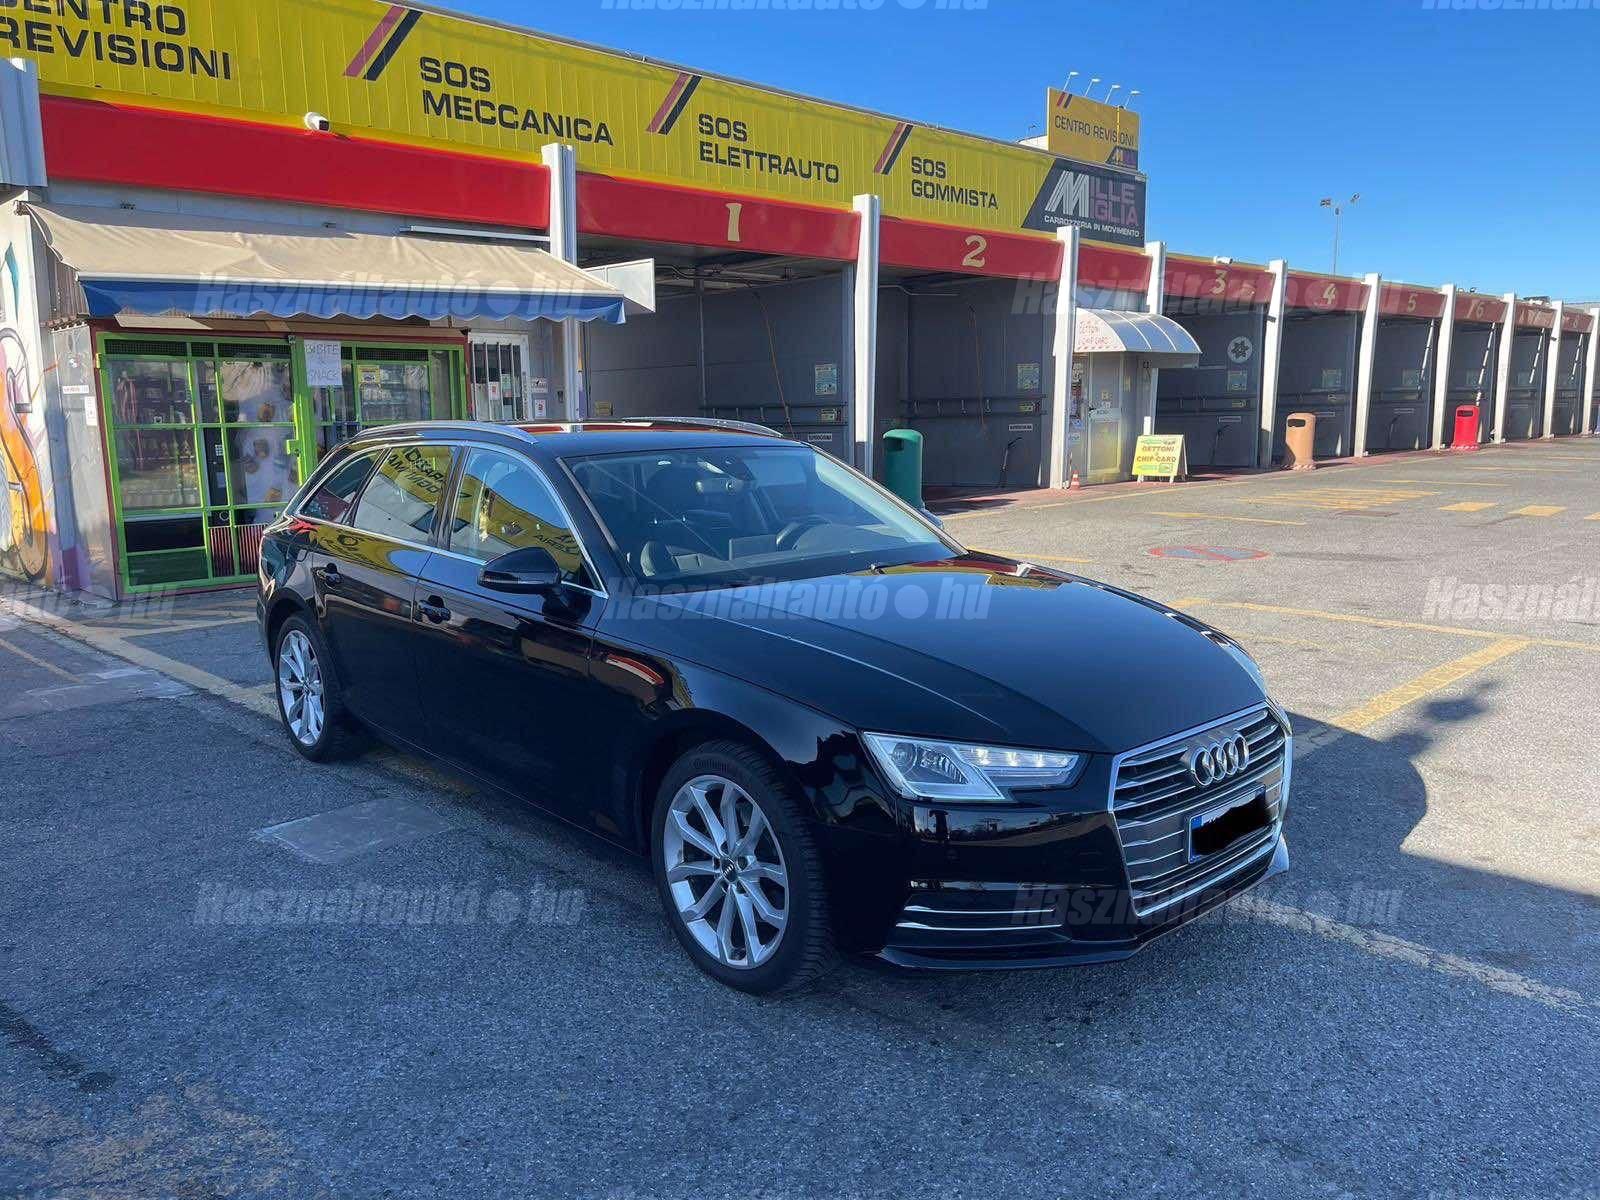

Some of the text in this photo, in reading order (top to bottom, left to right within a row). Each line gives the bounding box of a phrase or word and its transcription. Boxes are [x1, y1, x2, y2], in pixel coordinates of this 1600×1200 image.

[0, 0, 186, 36] ENTRO
[0, 16, 231, 80] REVISIONI
[419, 57, 491, 93] SOS
[422, 90, 614, 146] MECCANICA
[698, 113, 748, 142] SOS
[1055, 115, 1134, 146] CENTRO REVISONI
[699, 141, 839, 184] ELETTRAUTO
[911, 157, 946, 179] SOS
[911, 179, 998, 209] GOMMISTA
[725, 202, 743, 242] 1
[1093, 223, 1101, 231] IN
[1102, 224, 1140, 237] MOVIMENTO
[961, 235, 987, 268] 2
[1211, 270, 1227, 294] 3
[1322, 283, 1337, 305] 4
[1407, 293, 1419, 313] 5
